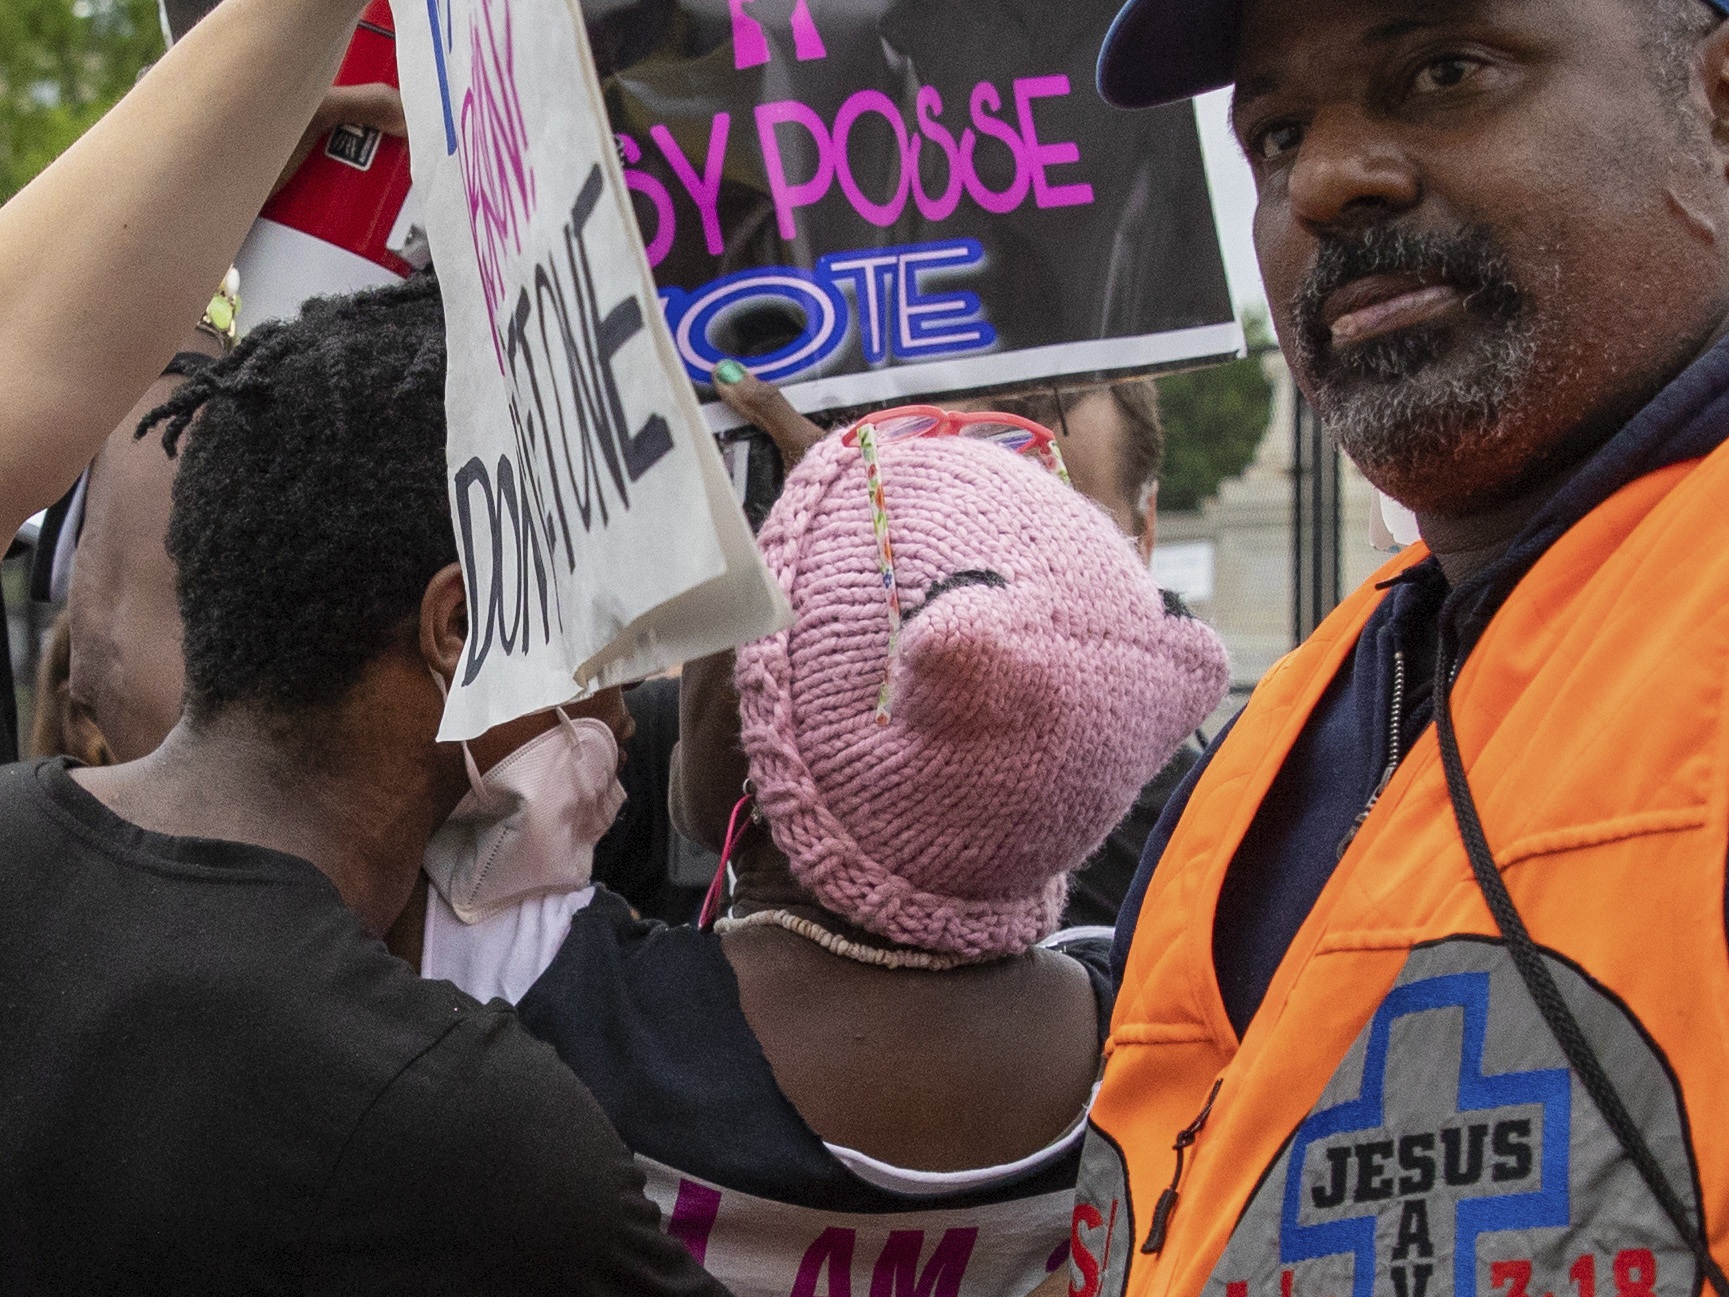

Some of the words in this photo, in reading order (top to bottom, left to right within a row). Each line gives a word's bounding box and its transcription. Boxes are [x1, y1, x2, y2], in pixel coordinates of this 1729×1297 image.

[754, 74, 1094, 240] POSSE
[657, 237, 998, 384] OTE
[1311, 1118, 1532, 1209] JESUS
